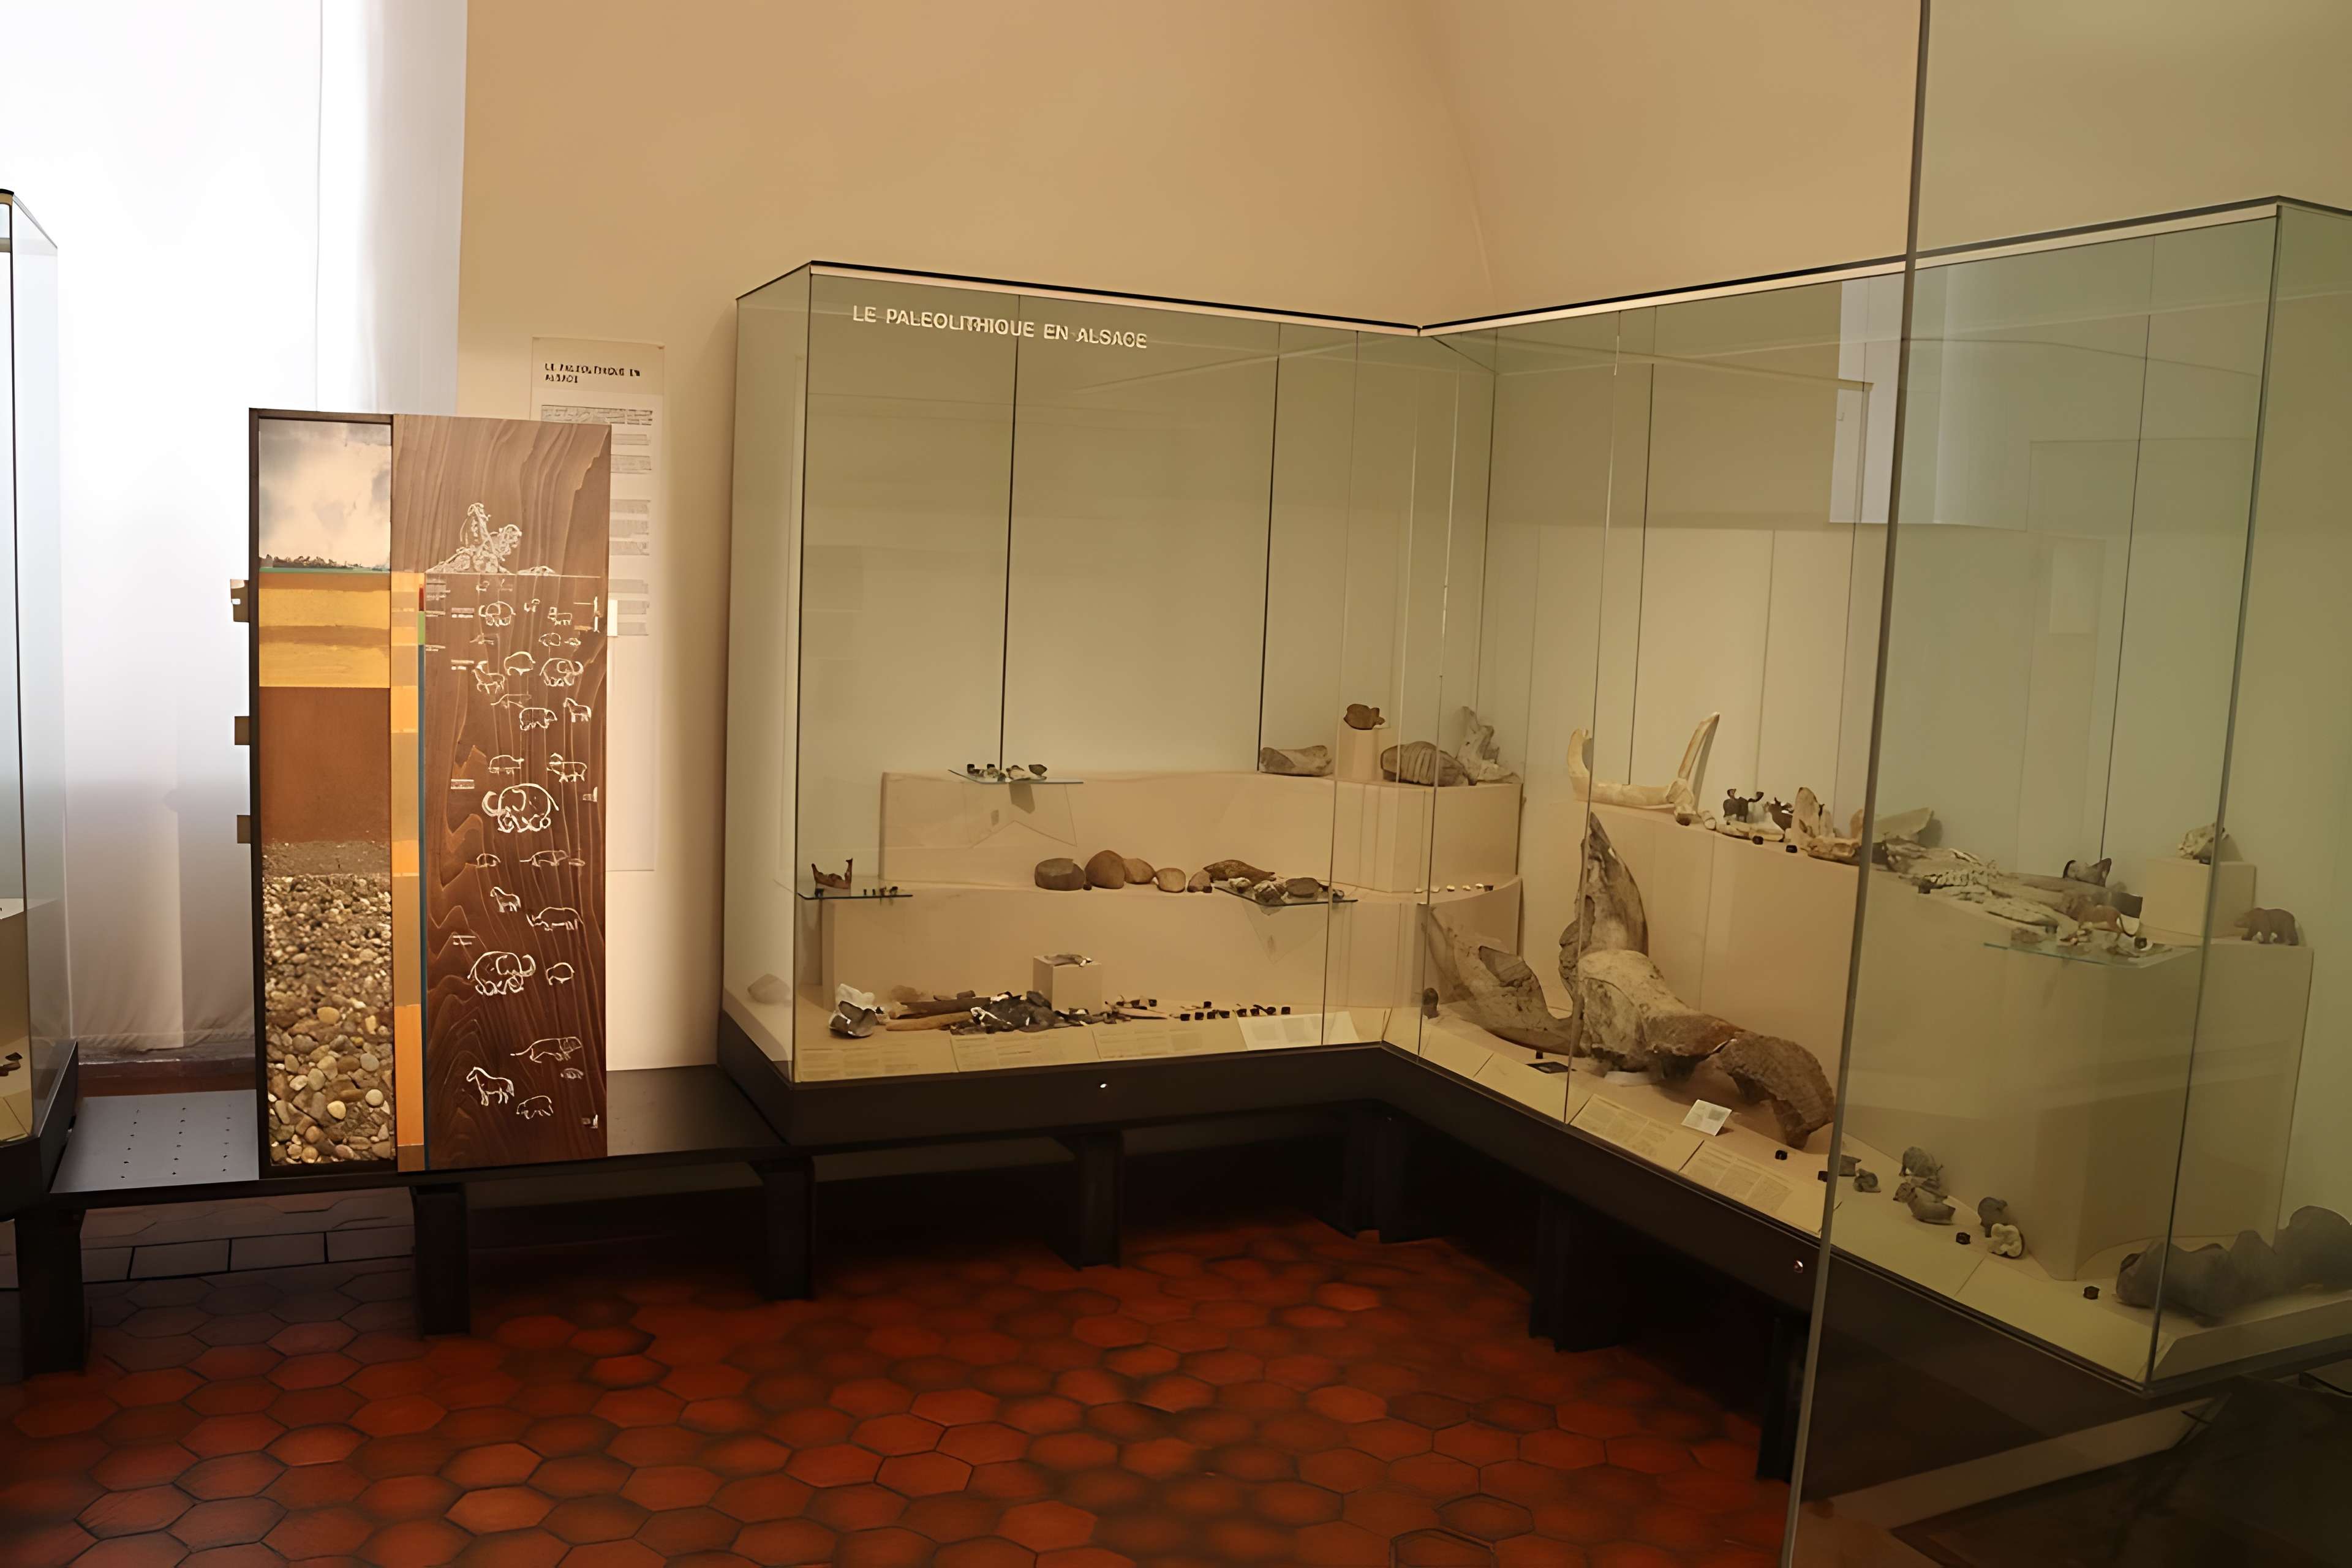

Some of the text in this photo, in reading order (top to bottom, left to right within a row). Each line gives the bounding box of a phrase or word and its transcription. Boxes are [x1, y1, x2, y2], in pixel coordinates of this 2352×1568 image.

[853, 305, 1147, 349] LE PALEOLITHIQUE EN ALSACE
